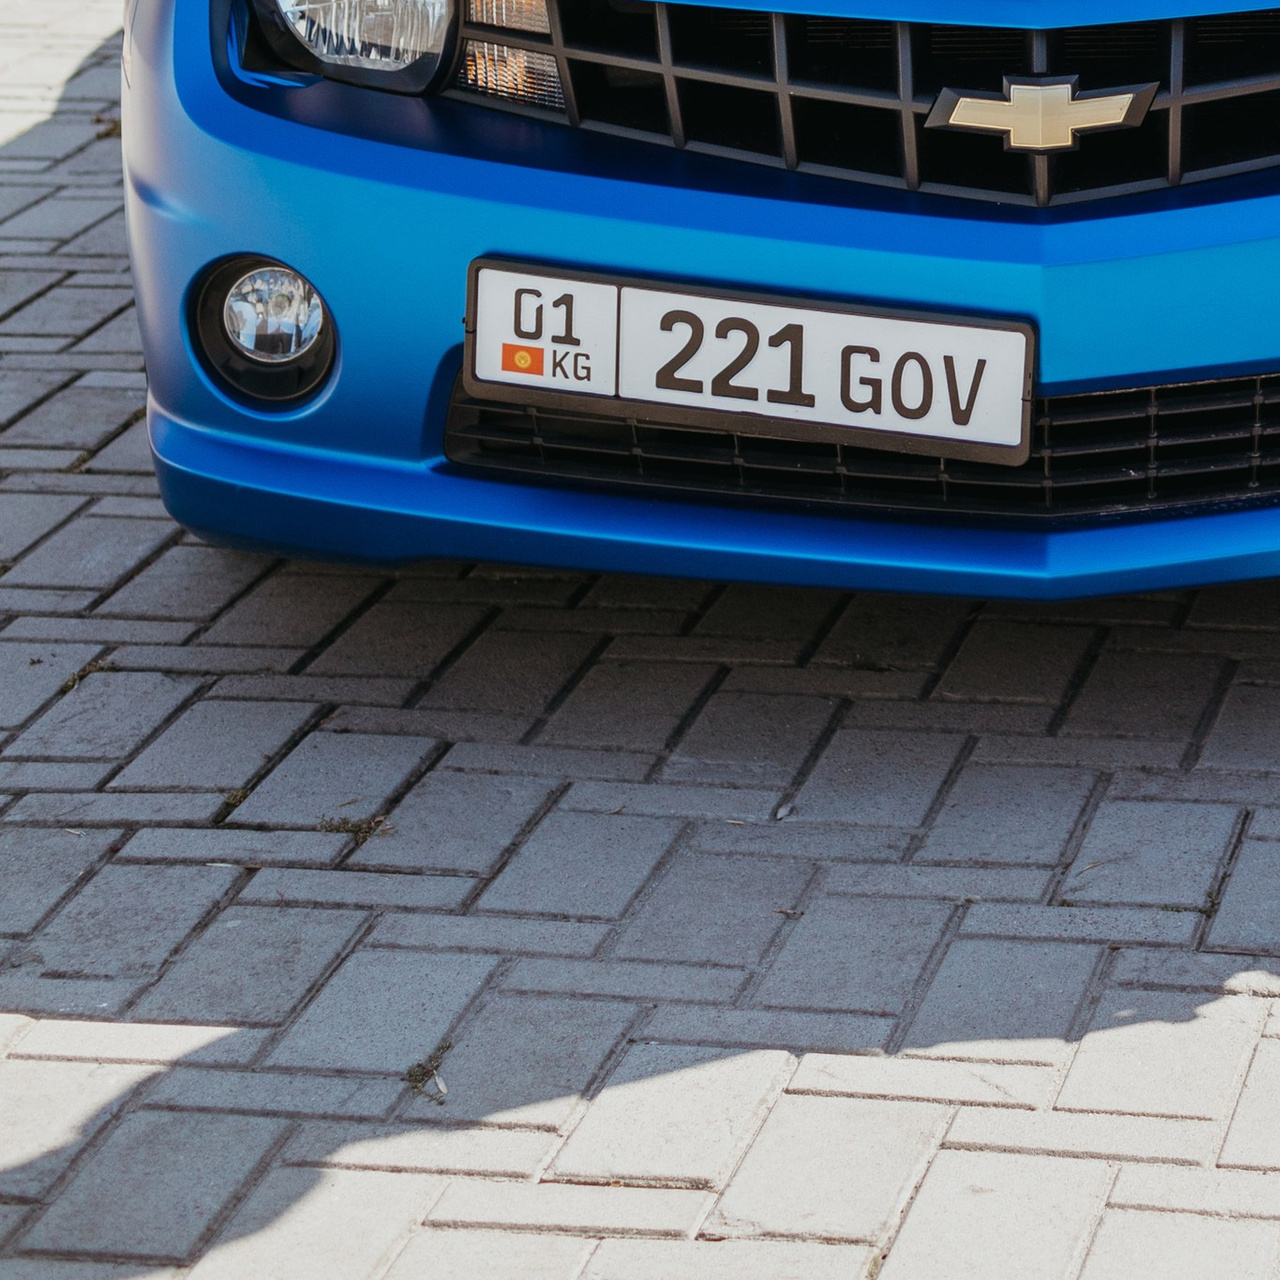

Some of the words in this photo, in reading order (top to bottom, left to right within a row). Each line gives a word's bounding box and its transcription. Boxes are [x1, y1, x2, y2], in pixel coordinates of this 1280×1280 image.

[513, 287, 581, 346] 01
[551, 349, 592, 382] KG
[654, 309, 816, 408] 221
[840, 344, 987, 426] GOV
